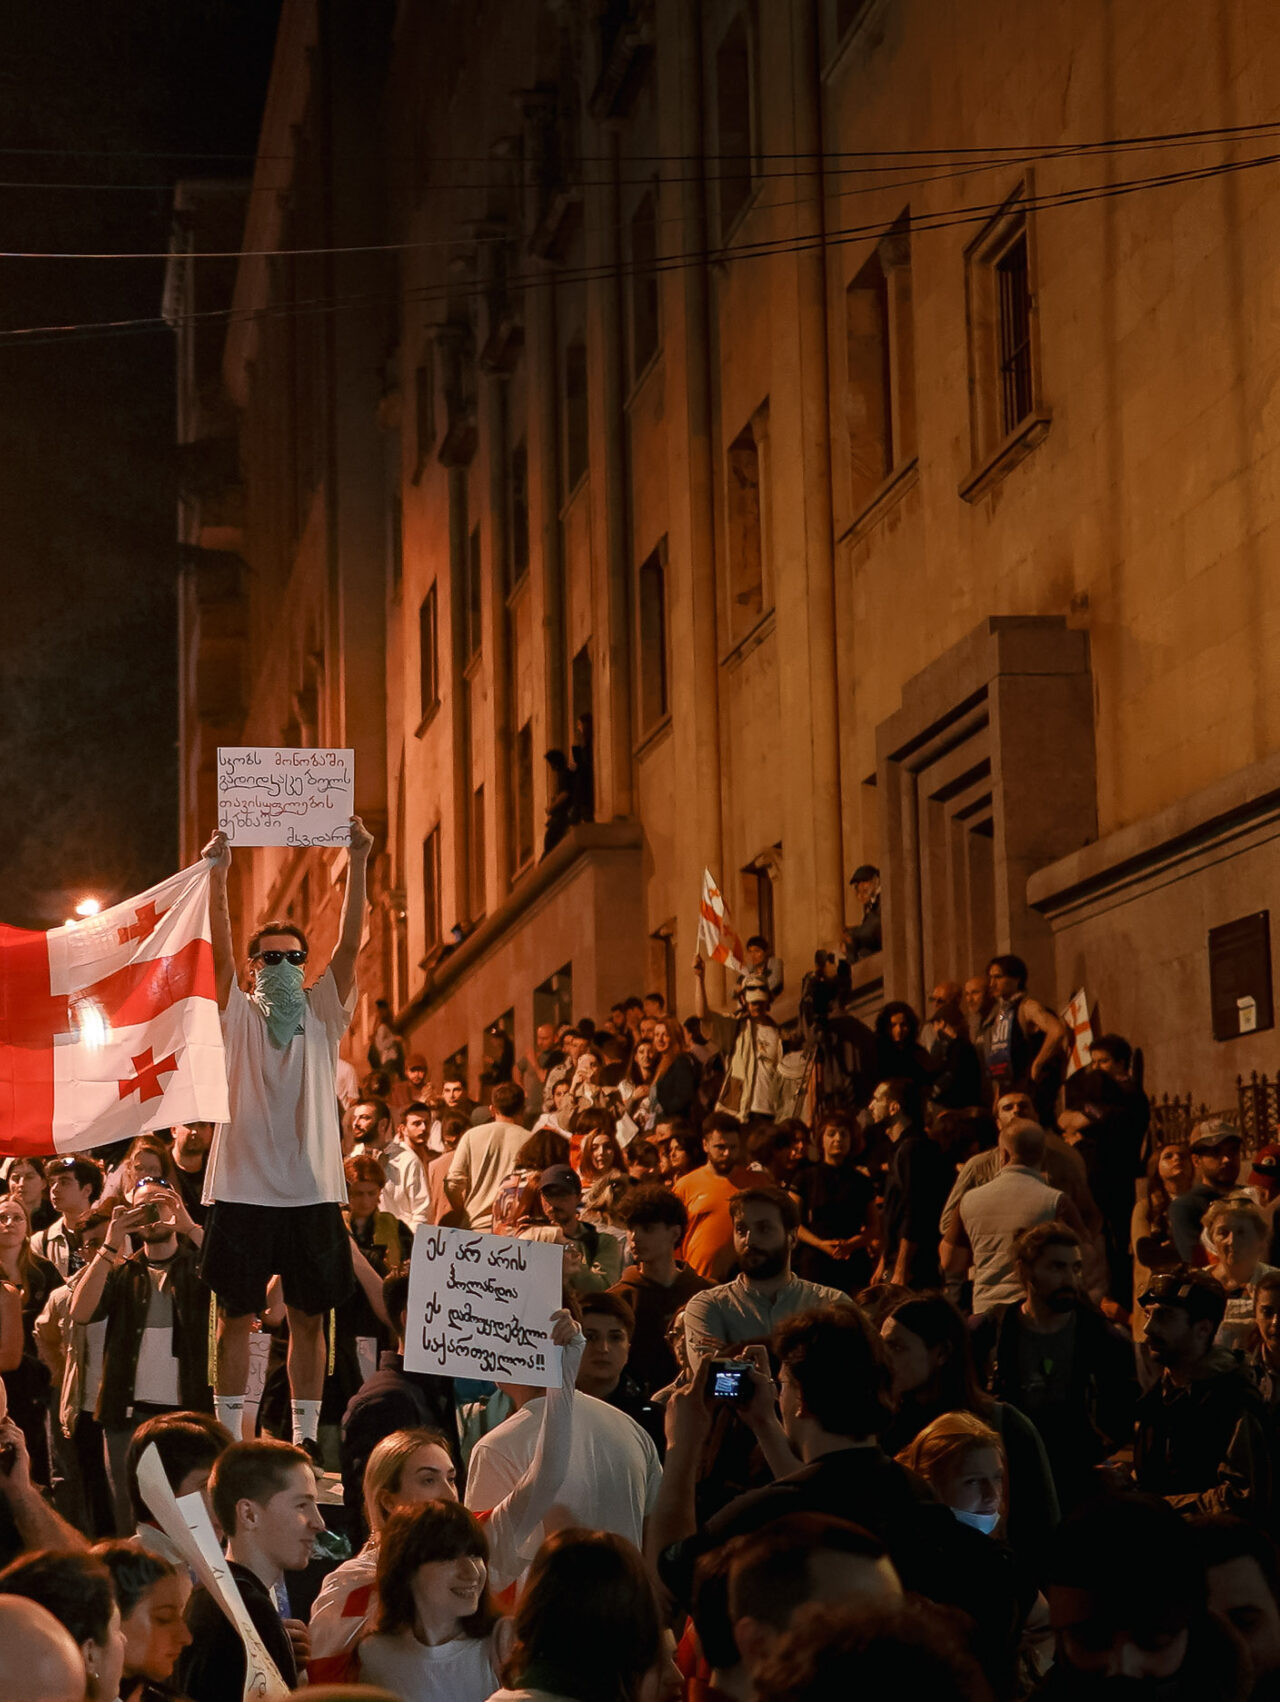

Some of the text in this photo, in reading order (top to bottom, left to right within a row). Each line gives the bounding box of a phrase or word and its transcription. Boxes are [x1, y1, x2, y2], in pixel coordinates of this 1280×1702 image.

[219, 748, 344, 775] სჯობს მონობაში
[220, 795, 333, 816] თავისუფლების
[220, 810, 281, 841] ძებნაში
[427, 1229, 527, 1271] ეს არ არის
[447, 1263, 518, 1303] ჰოლანდია
[425, 1292, 441, 1324] ეს
[422, 1326, 545, 1376] საქართველოა!!
